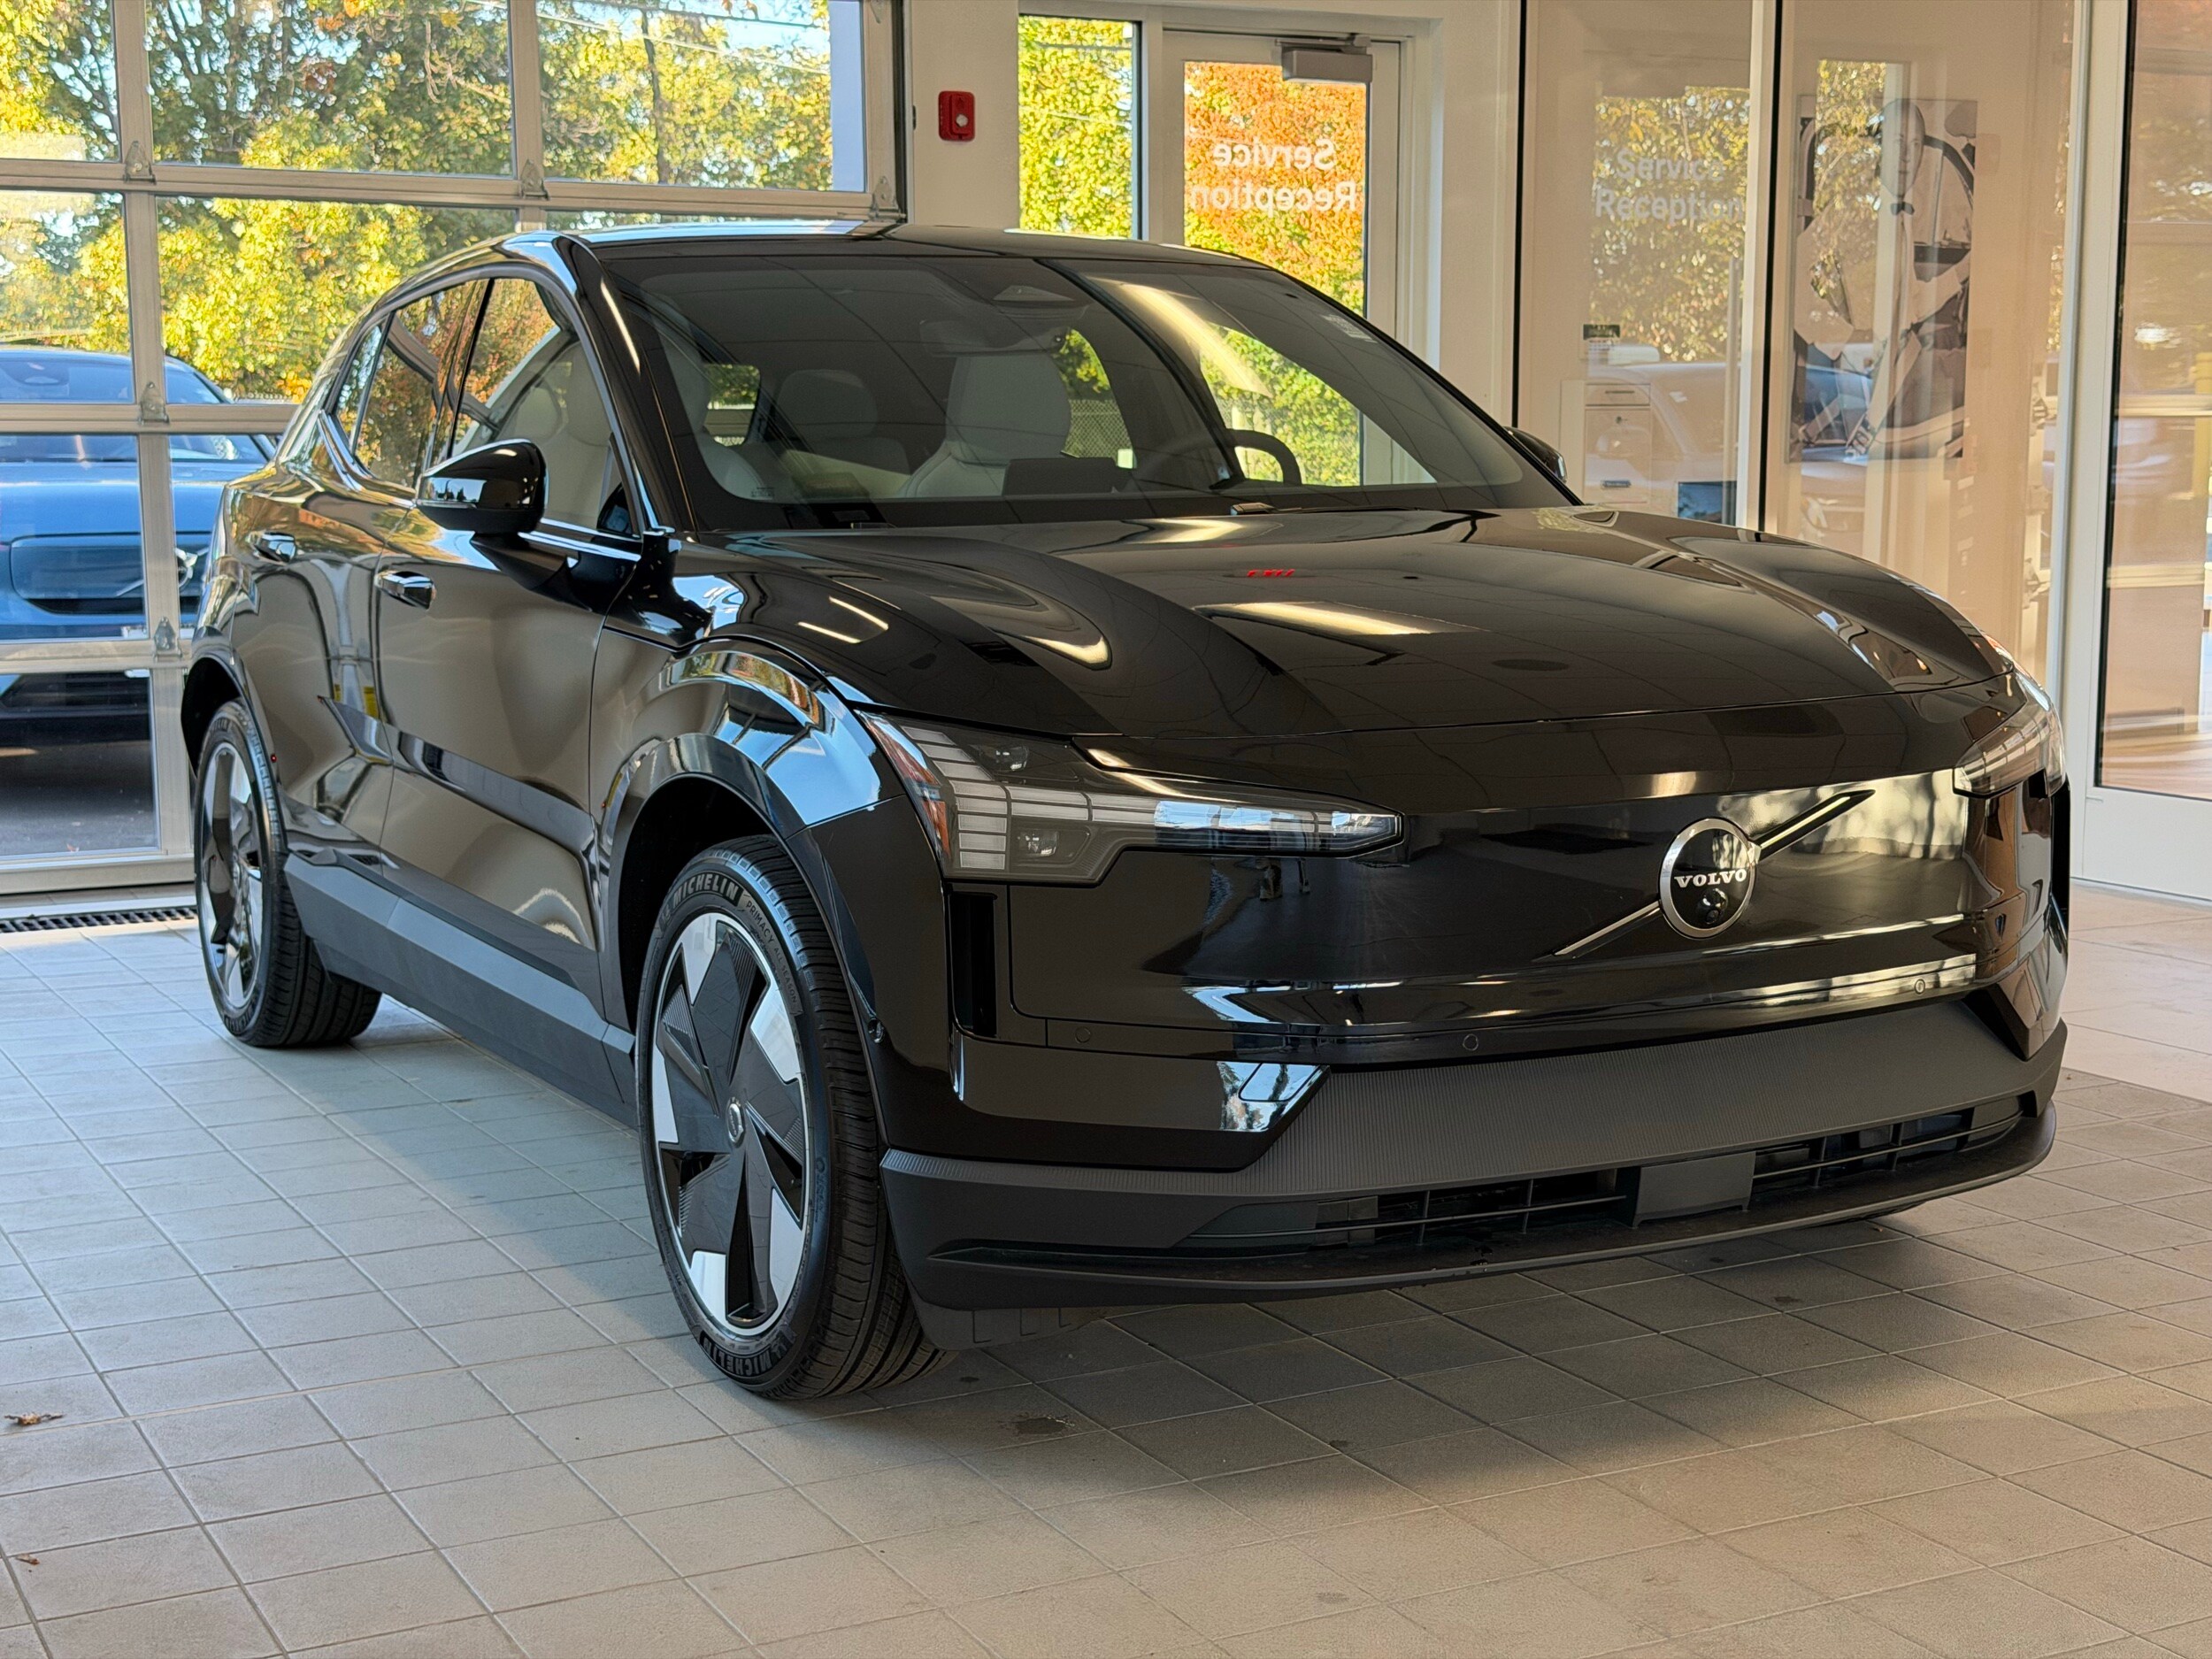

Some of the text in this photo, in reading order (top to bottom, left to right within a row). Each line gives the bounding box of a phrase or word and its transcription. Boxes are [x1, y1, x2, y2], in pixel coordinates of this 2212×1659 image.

[1615, 148, 1724, 182] Service
[1594, 188, 1743, 227] Reception
[672, 873, 740, 908] MICHELIN
[1673, 868, 1747, 888] VOLVO
[746, 900, 774, 943] PRIMACY
[703, 1337, 772, 1377] MICHELIN
